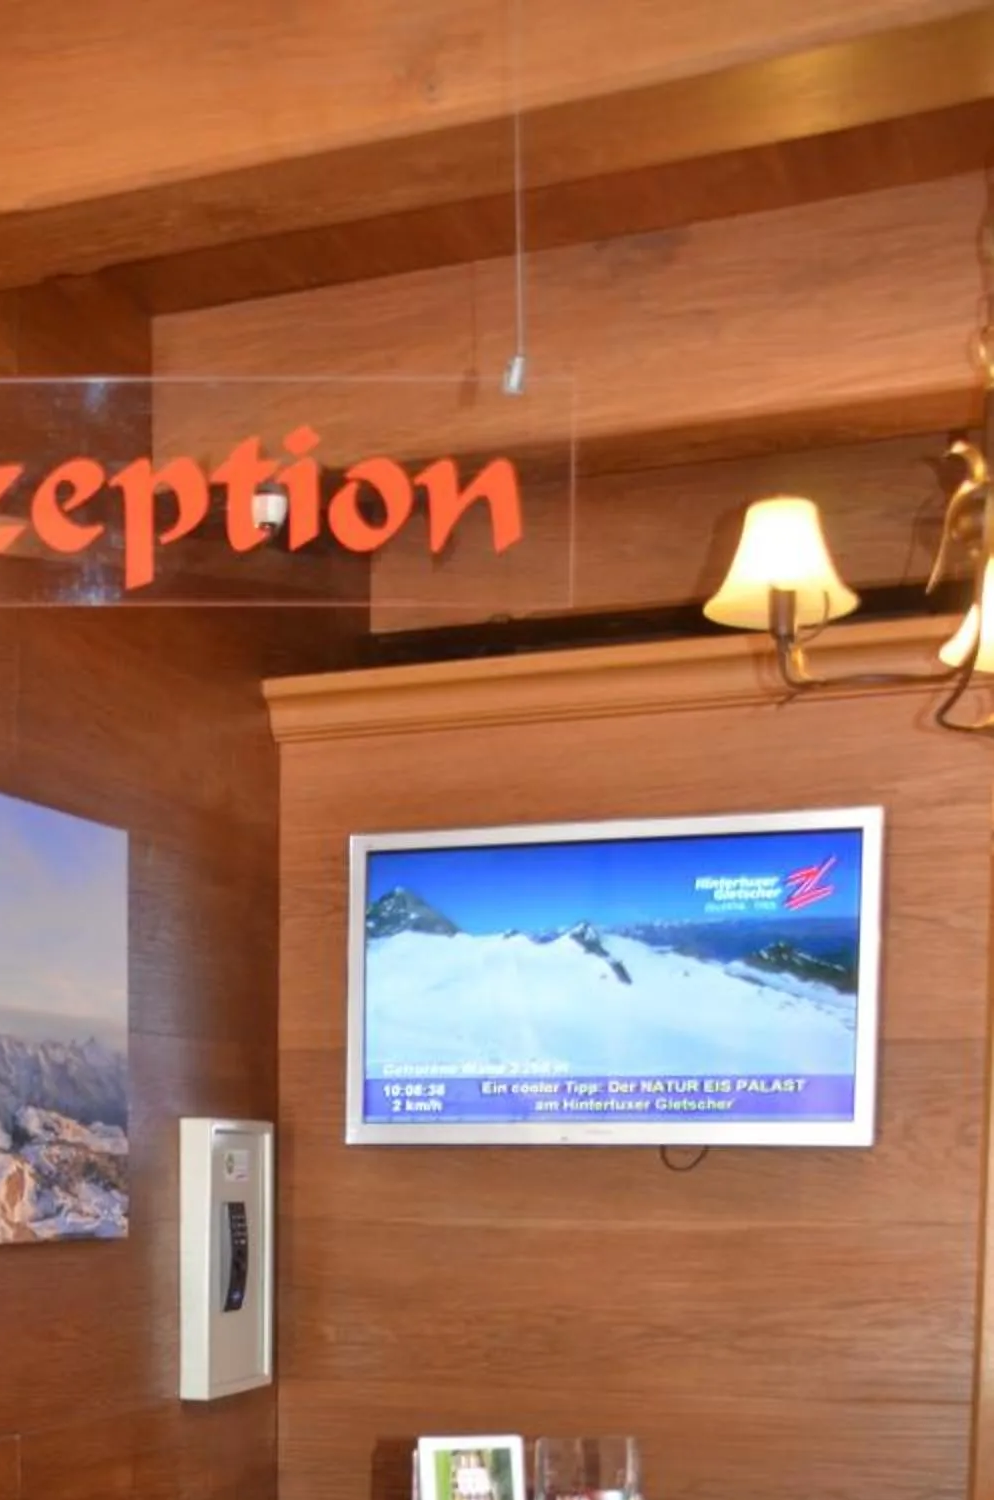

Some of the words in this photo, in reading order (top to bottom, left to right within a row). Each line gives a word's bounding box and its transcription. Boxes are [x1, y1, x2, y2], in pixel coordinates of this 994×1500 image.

[608, 1080, 636, 1094] Der
[641, 1079, 699, 1093] NATUR
[703, 1079, 732, 1093] EIS
[736, 1078, 805, 1092] PALAST
